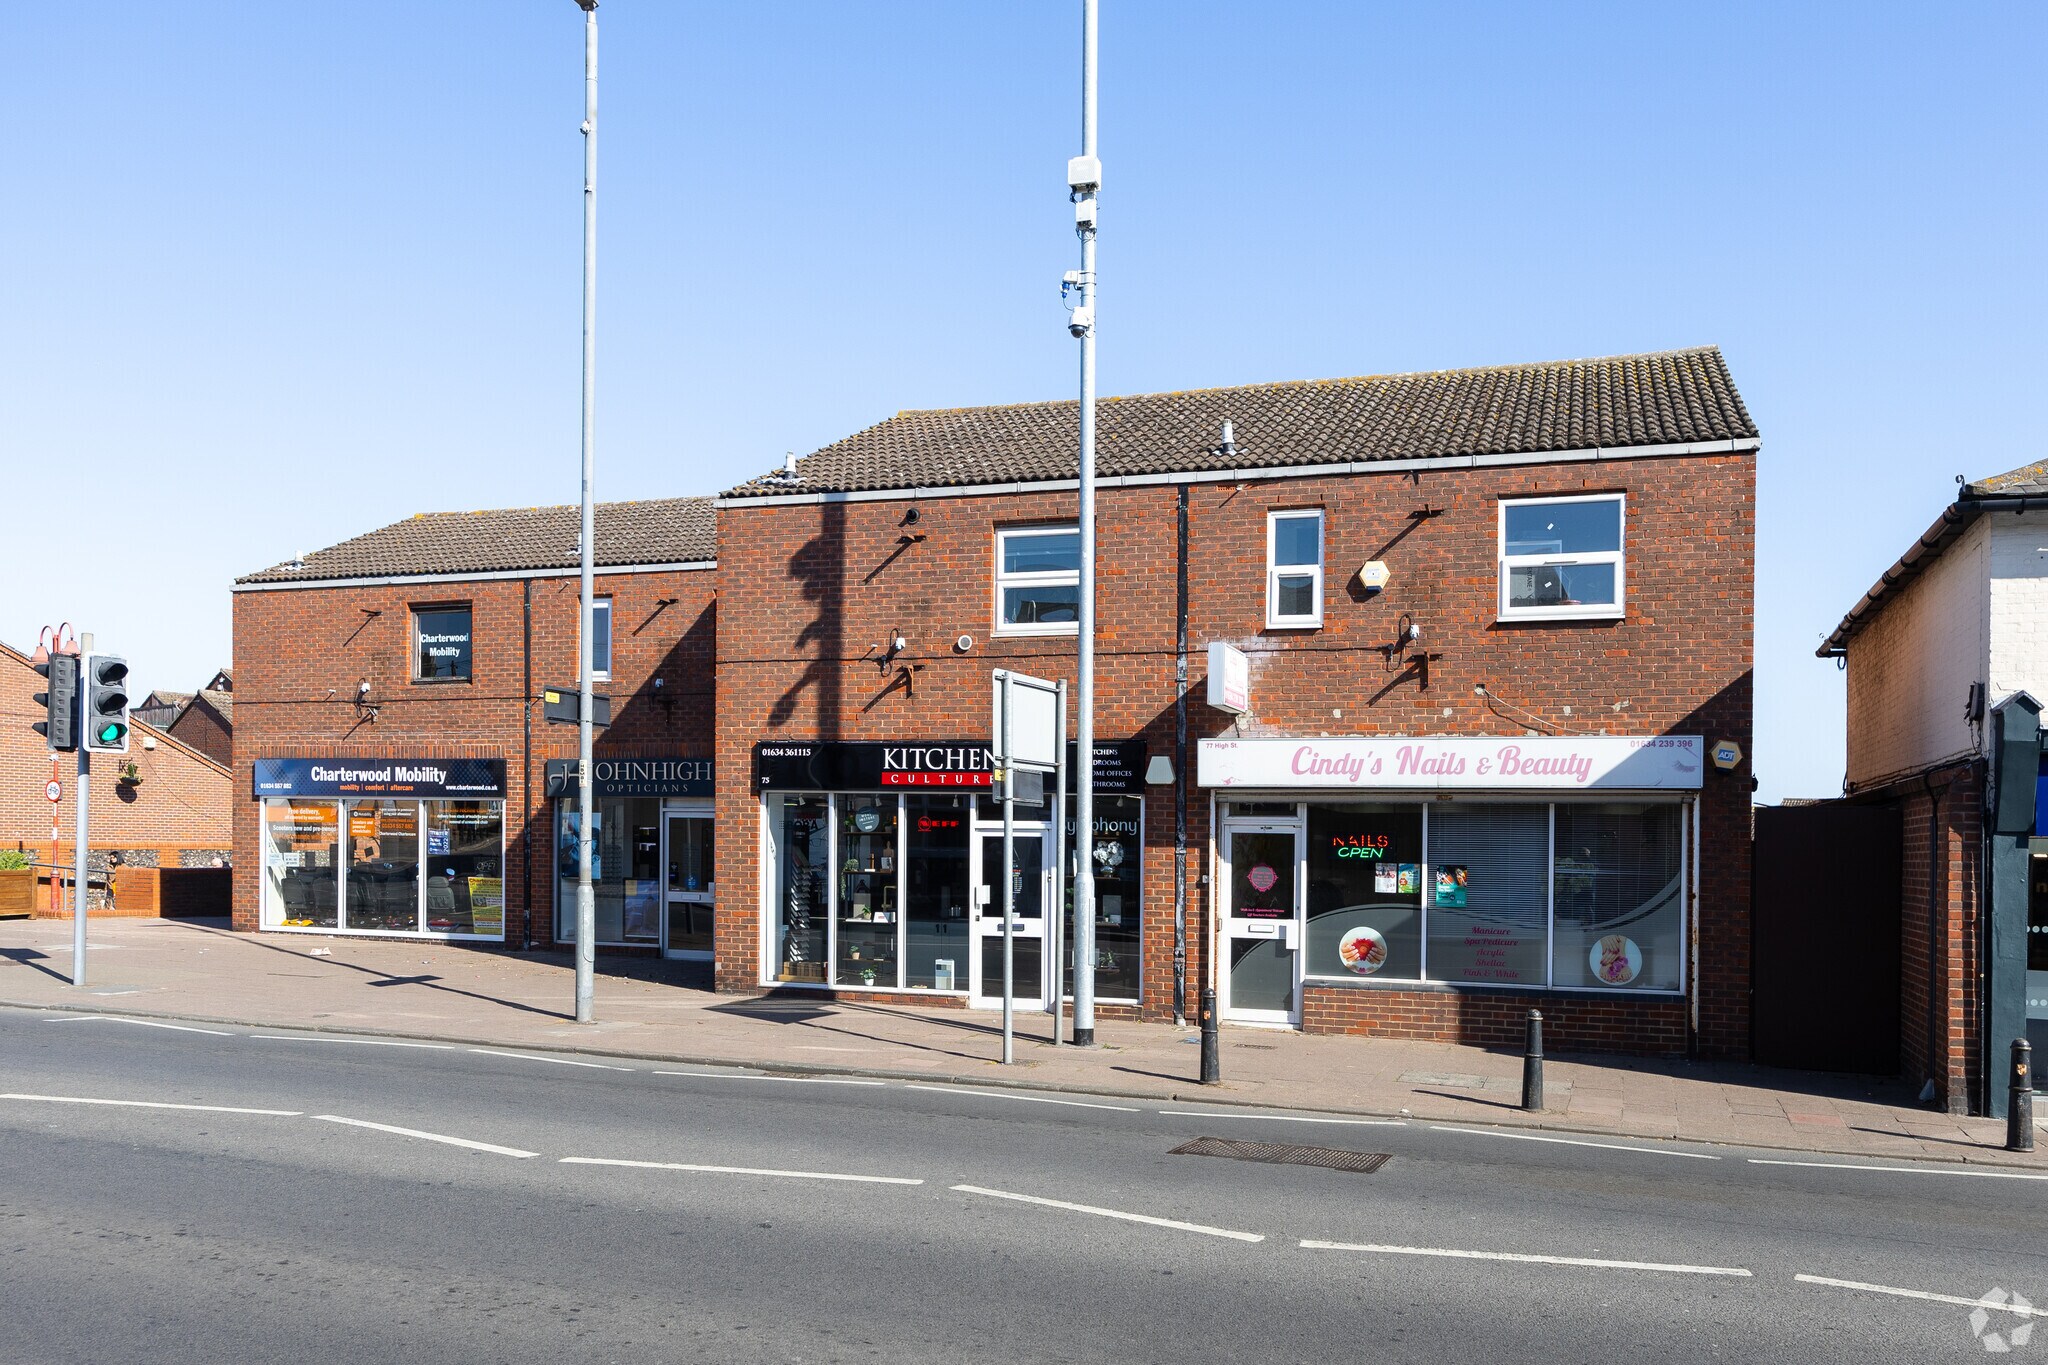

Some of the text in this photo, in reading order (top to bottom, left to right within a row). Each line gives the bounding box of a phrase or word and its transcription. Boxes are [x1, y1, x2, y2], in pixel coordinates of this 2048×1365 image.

[421, 633, 469, 643] Charterwood
[430, 647, 460, 657] Mobility
[1630, 740, 1656, 748] 01634
[1659, 740, 1674, 748] 239
[762, 748, 811, 756] 01634 361115
[1717, 751, 1735, 760] ADT
[1291, 745, 1593, 783] Cindy's Nails & Beauty
[311, 766, 446, 785] Charterwood Mobility
[592, 761, 712, 781] OHNHIGH
[340, 783, 360, 792] mobility
[365, 783, 385, 791] comfort
[607, 783, 688, 793] OPTICIANS
[1065, 817, 1137, 836] yphony
[1333, 835, 1389, 847] NAILS
[1471, 926, 1511, 935] Manicure
[1476, 949, 1505, 957] Acrylic
[1475, 959, 1506, 967] Shellac
[1463, 968, 1481, 976] Pink
[1494, 969, 1519, 978] White
